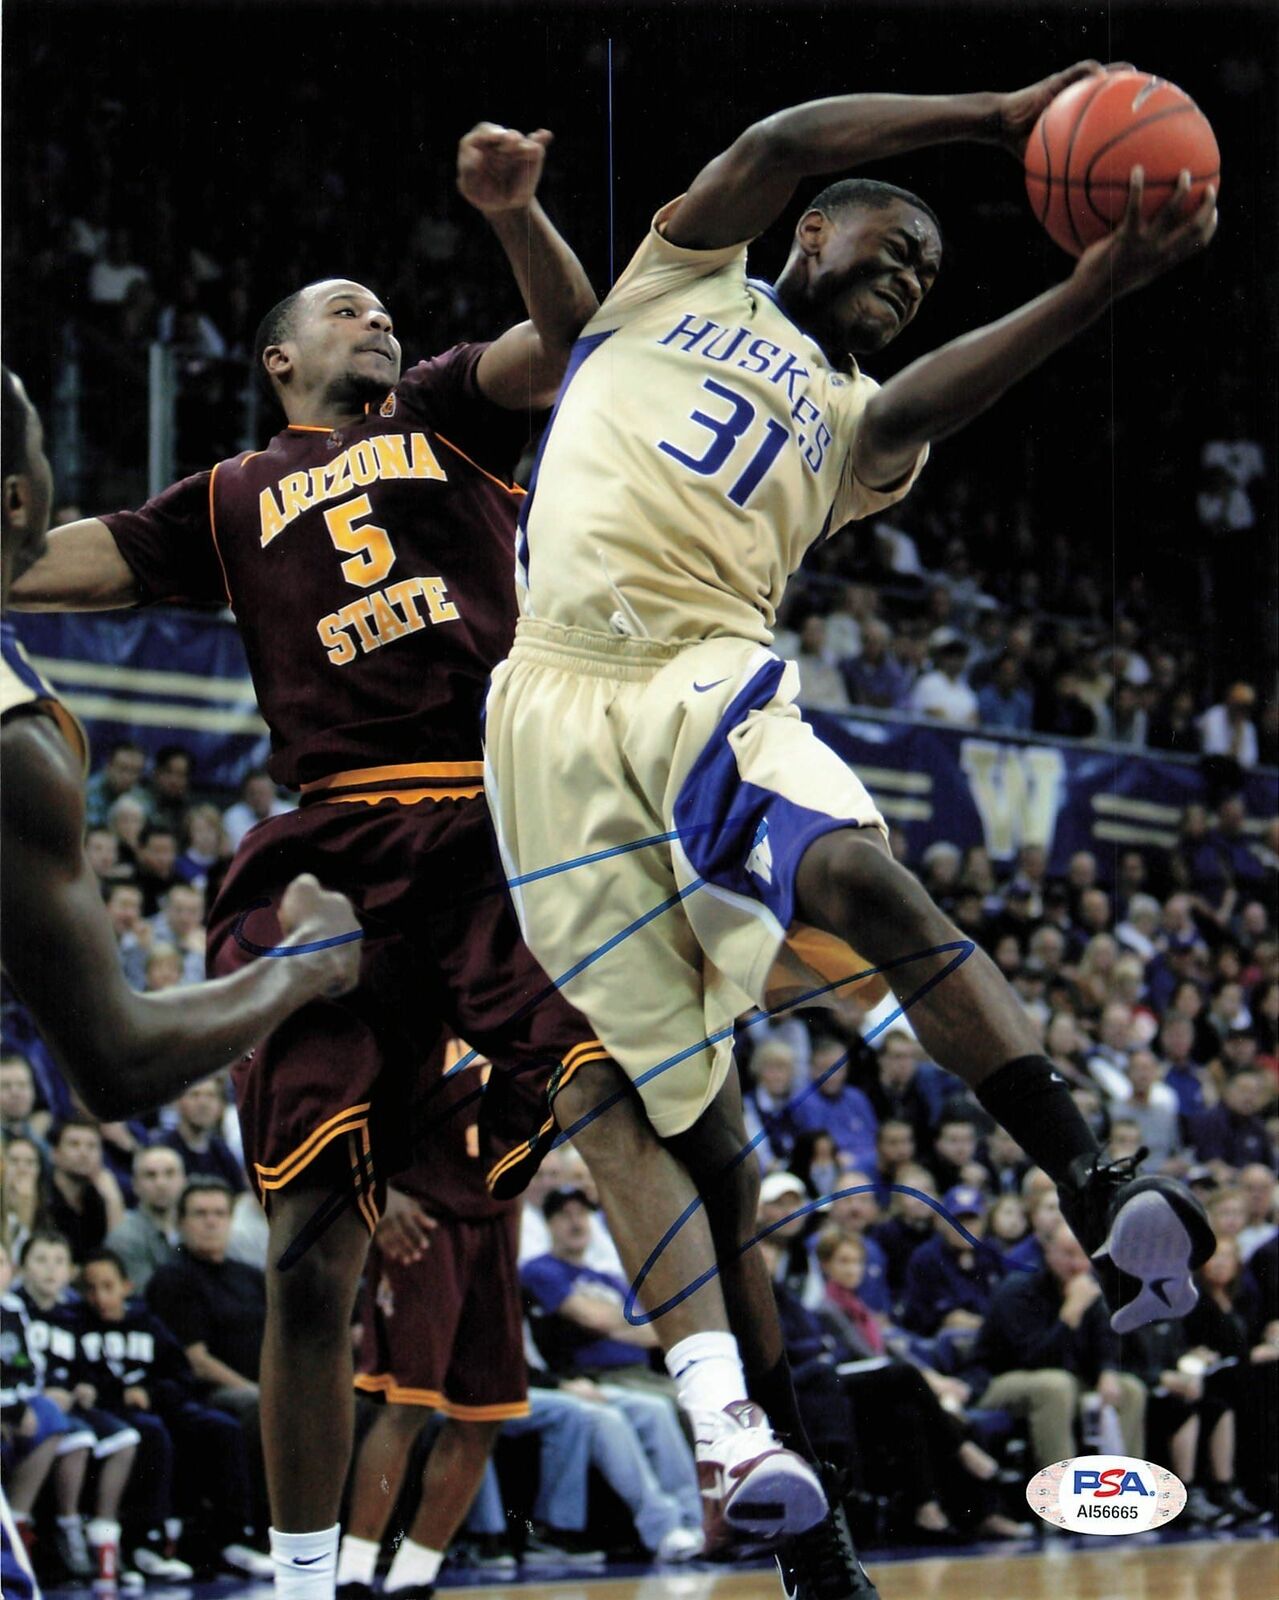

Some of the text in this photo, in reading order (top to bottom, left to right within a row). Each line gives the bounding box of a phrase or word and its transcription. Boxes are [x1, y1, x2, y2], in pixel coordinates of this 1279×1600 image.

[657, 314, 832, 474] HUSKES
[259, 432, 449, 549] ARIZONA
[657, 377, 790, 508] 31
[323, 492, 397, 588] 5
[316, 576, 461, 666] STATE
[1073, 1468, 1149, 1498] PSA
[1077, 1504, 1139, 1520] AI56665
